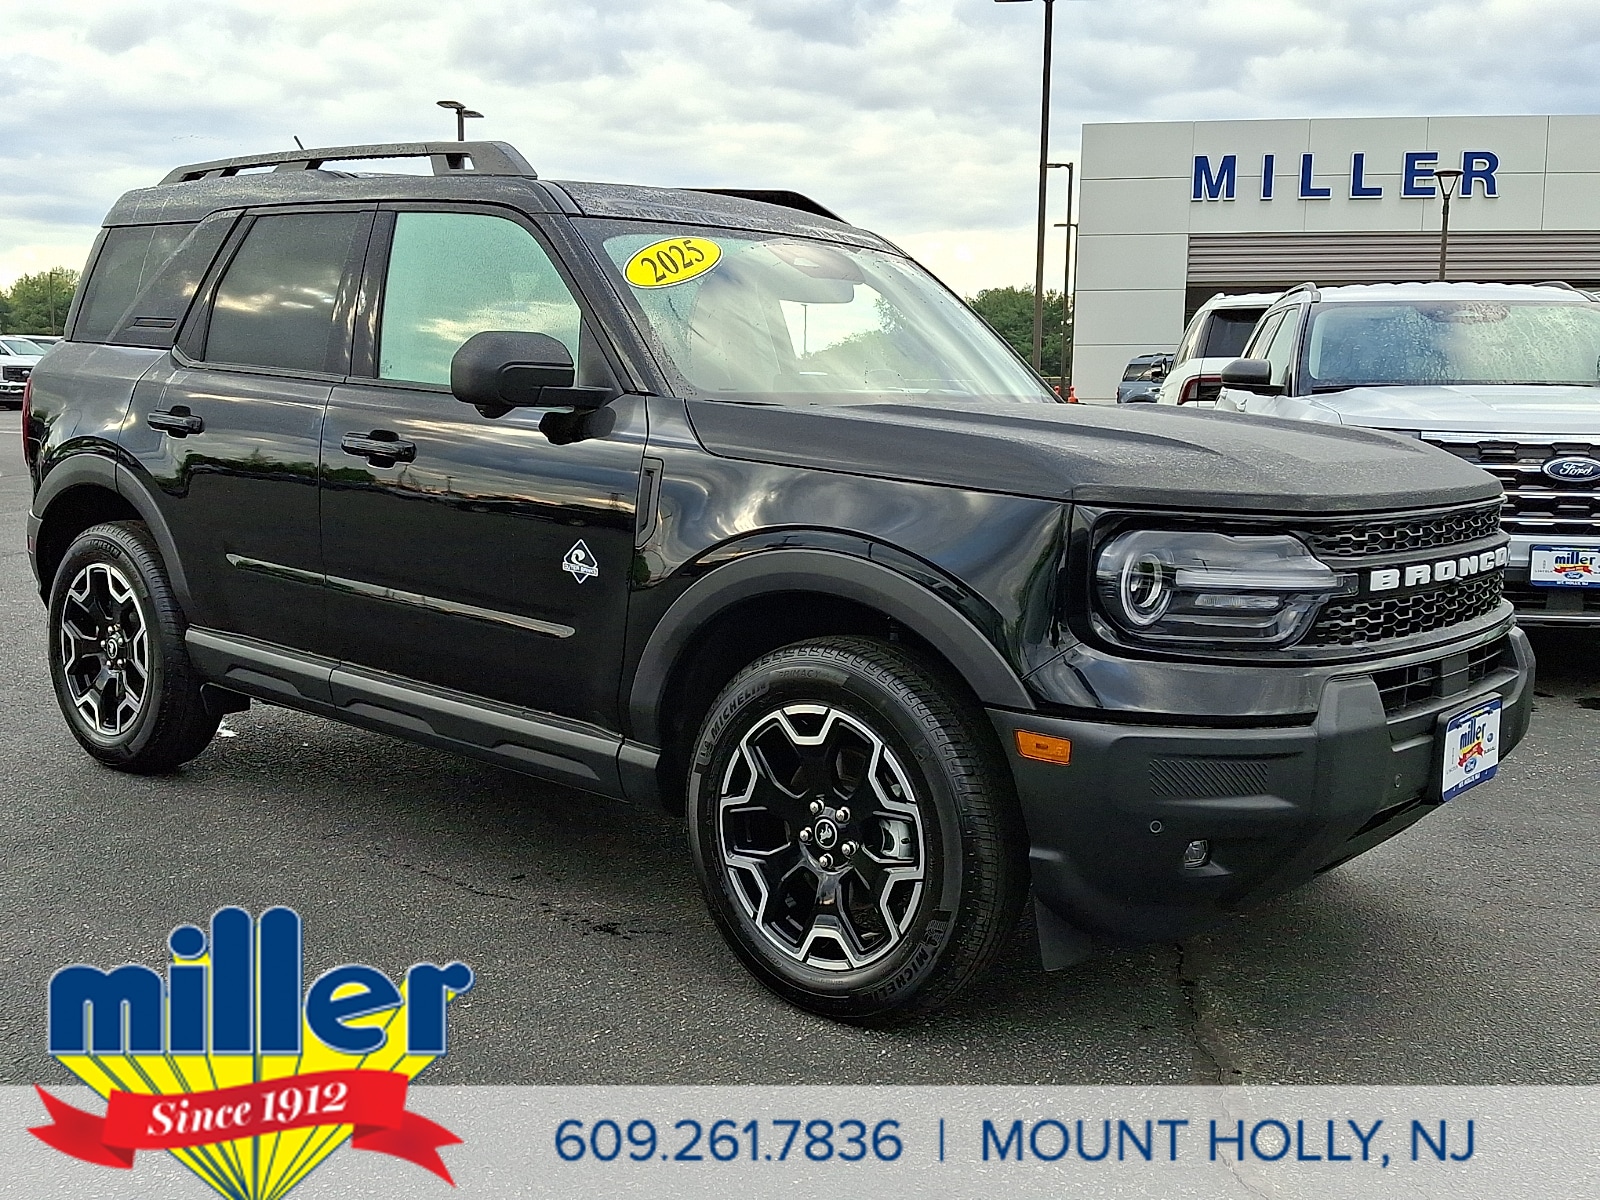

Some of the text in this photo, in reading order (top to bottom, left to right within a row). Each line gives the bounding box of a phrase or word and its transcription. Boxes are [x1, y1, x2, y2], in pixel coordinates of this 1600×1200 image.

[1191, 151, 1500, 201] MILLER
[641, 239, 704, 283] 2025
[1559, 462, 1594, 476] Ford
[1370, 546, 1508, 592] BRONCO
[1554, 551, 1596, 565] miller
[710, 682, 767, 740] MICHELIN
[1459, 717, 1487, 750] miller
